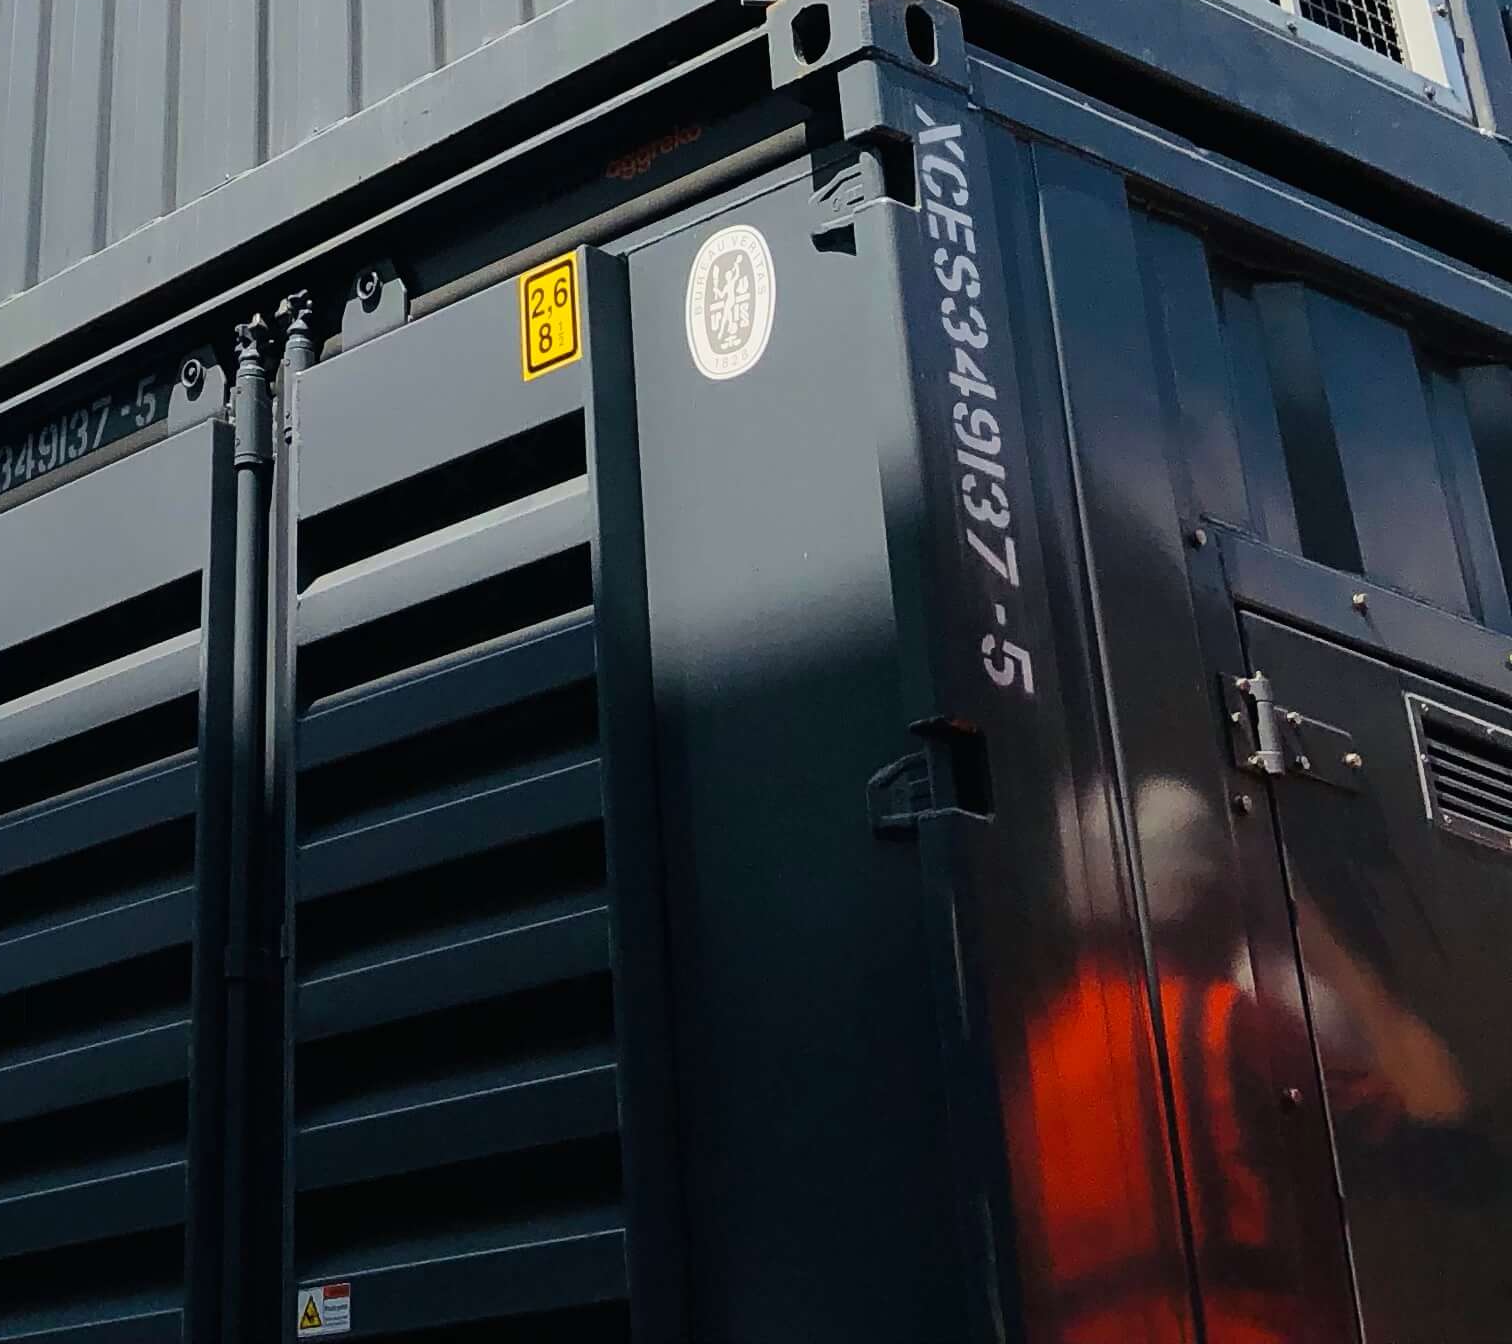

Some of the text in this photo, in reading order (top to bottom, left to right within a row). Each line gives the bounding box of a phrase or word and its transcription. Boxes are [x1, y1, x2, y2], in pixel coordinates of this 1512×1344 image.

[693, 234, 768, 316] BUREAU VERITAS
[531, 277, 569, 320] 2,6
[713, 347, 753, 371] 1828
